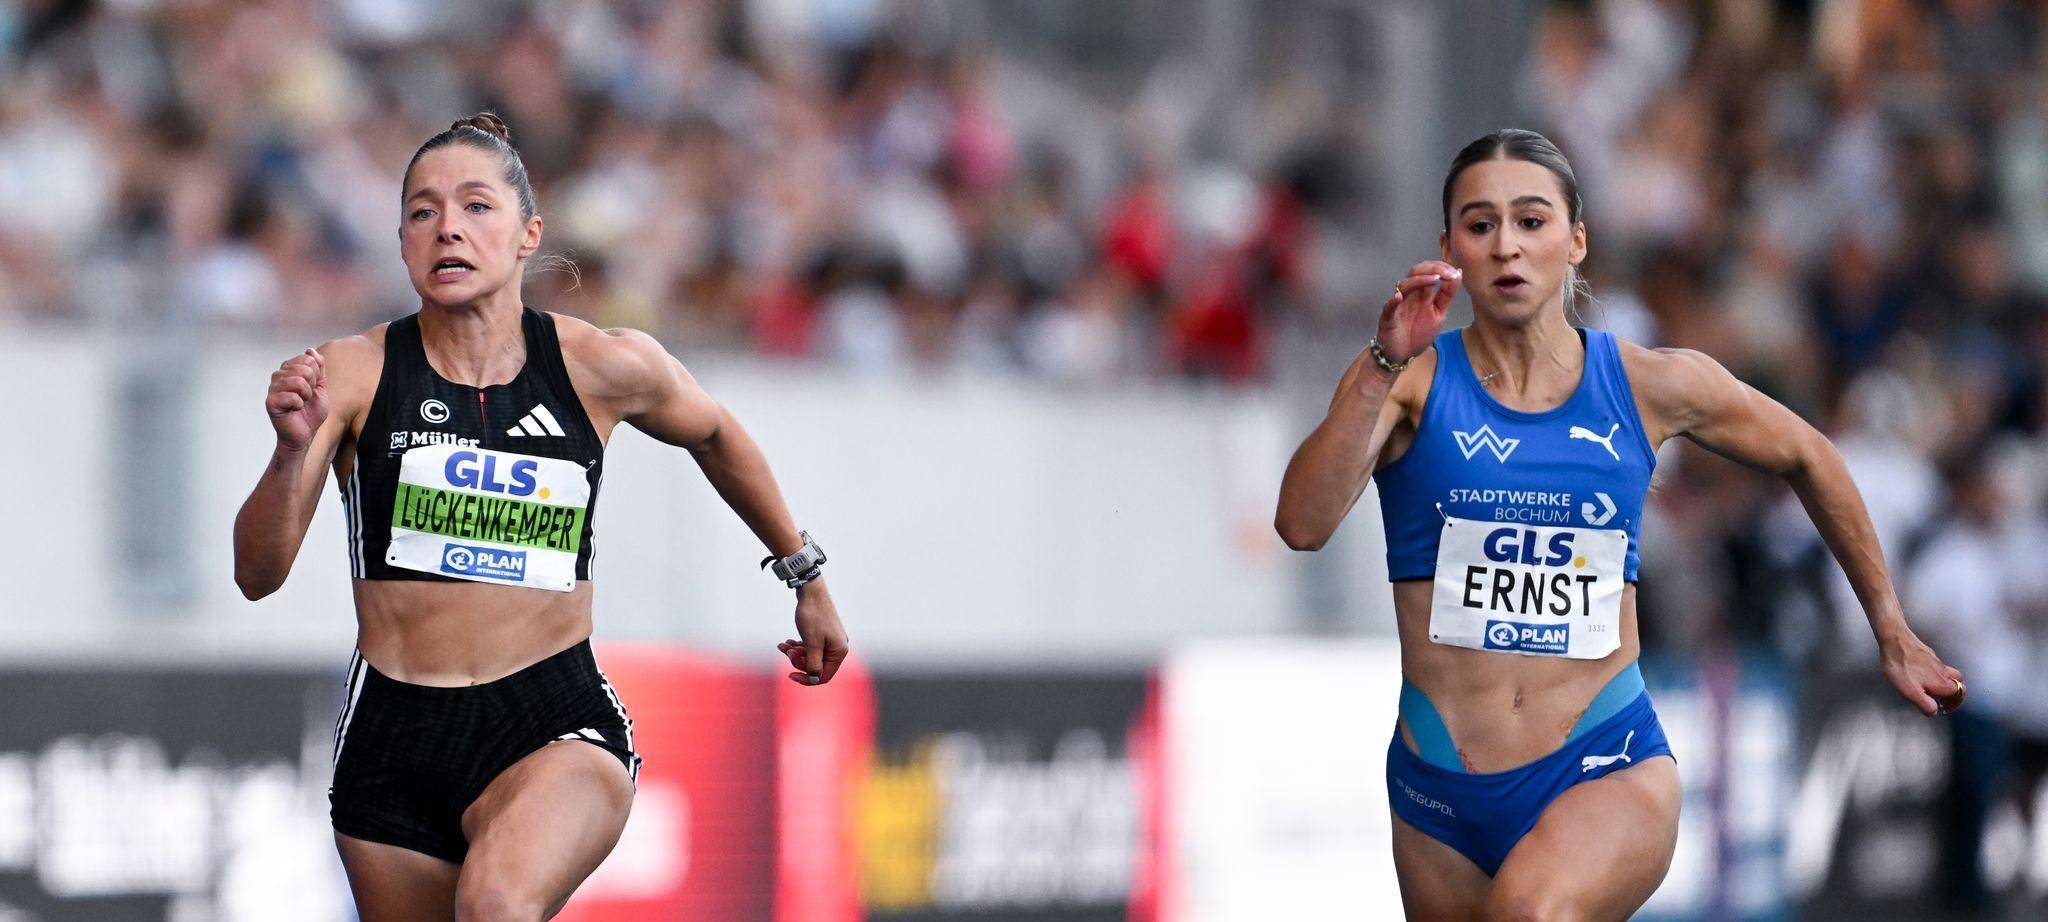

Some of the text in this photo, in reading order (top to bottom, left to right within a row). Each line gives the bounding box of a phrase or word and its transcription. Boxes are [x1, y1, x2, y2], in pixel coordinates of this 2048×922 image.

[410, 431, 481, 448] Müller
[1449, 488, 1571, 507] STADTWERKE
[401, 485, 576, 551] LÜCKENKEMPER
[1494, 506, 1571, 524] BOCHUM
[476, 552, 524, 571] PLAN
[475, 567, 522, 578] INTERNATIONAL
[1463, 565, 1597, 616] ERNST
[1520, 628, 1567, 643] PLAN
[1520, 642, 1566, 651] INTERNATIONAL
[1404, 785, 1457, 818] REGUPOL
